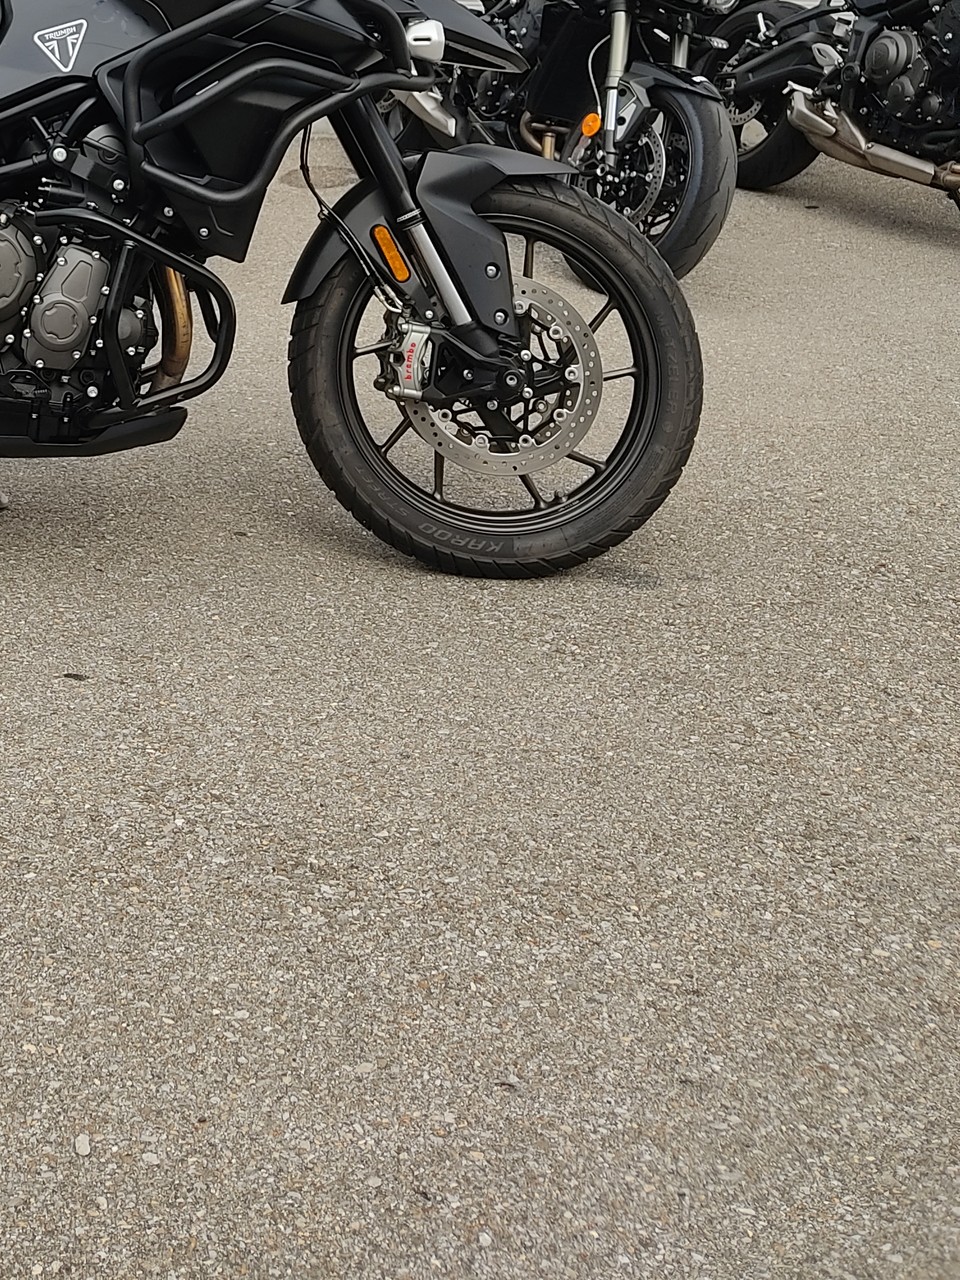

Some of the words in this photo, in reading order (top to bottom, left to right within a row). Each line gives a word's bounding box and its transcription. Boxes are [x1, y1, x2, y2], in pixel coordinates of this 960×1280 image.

[44, 26, 77, 40] TRIUMPH
[404, 342, 417, 380] brembo
[418, 522, 504, 552] KAROO
